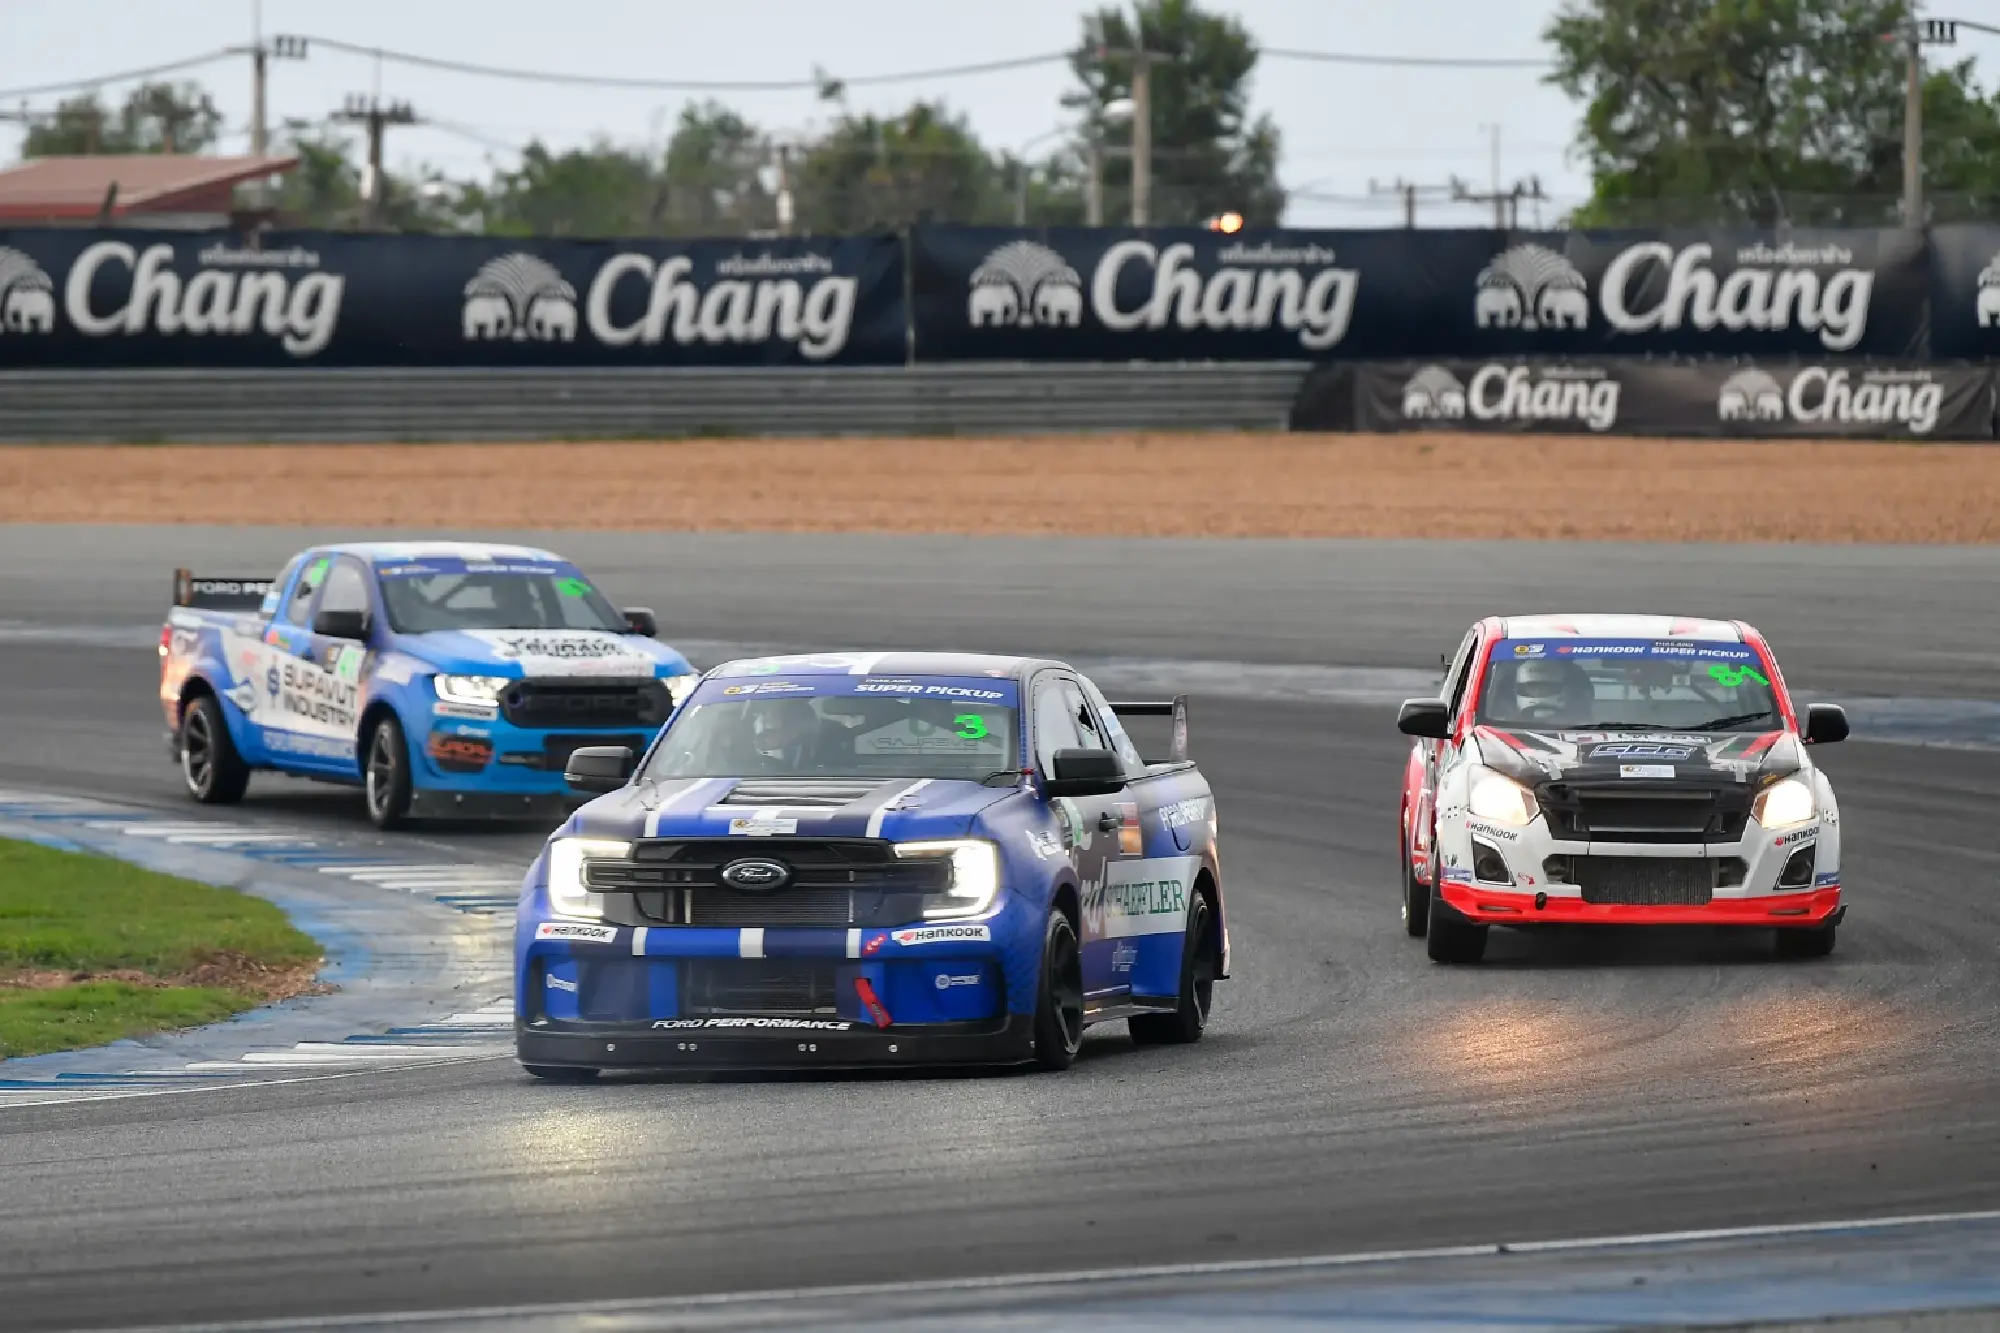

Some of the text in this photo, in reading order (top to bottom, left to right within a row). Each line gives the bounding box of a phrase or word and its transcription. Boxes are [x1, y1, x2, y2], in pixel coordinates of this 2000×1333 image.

[66, 241, 344, 354] Chang
[587, 253, 857, 358] Chang
[1091, 240, 1358, 348] Chang
[1600, 241, 1876, 350] Chang
[1468, 363, 1620, 430] Chang
[1787, 366, 1944, 434] Chang
[193, 582, 241, 595] FORD
[1651, 646, 1696, 656] SUPER
[1698, 649, 1750, 658] PICKUP
[854, 683, 1004, 699] SUPER PICKUP
[953, 713, 988, 740] 3
[651, 1017, 851, 1031] FORD PERFORMANCE
